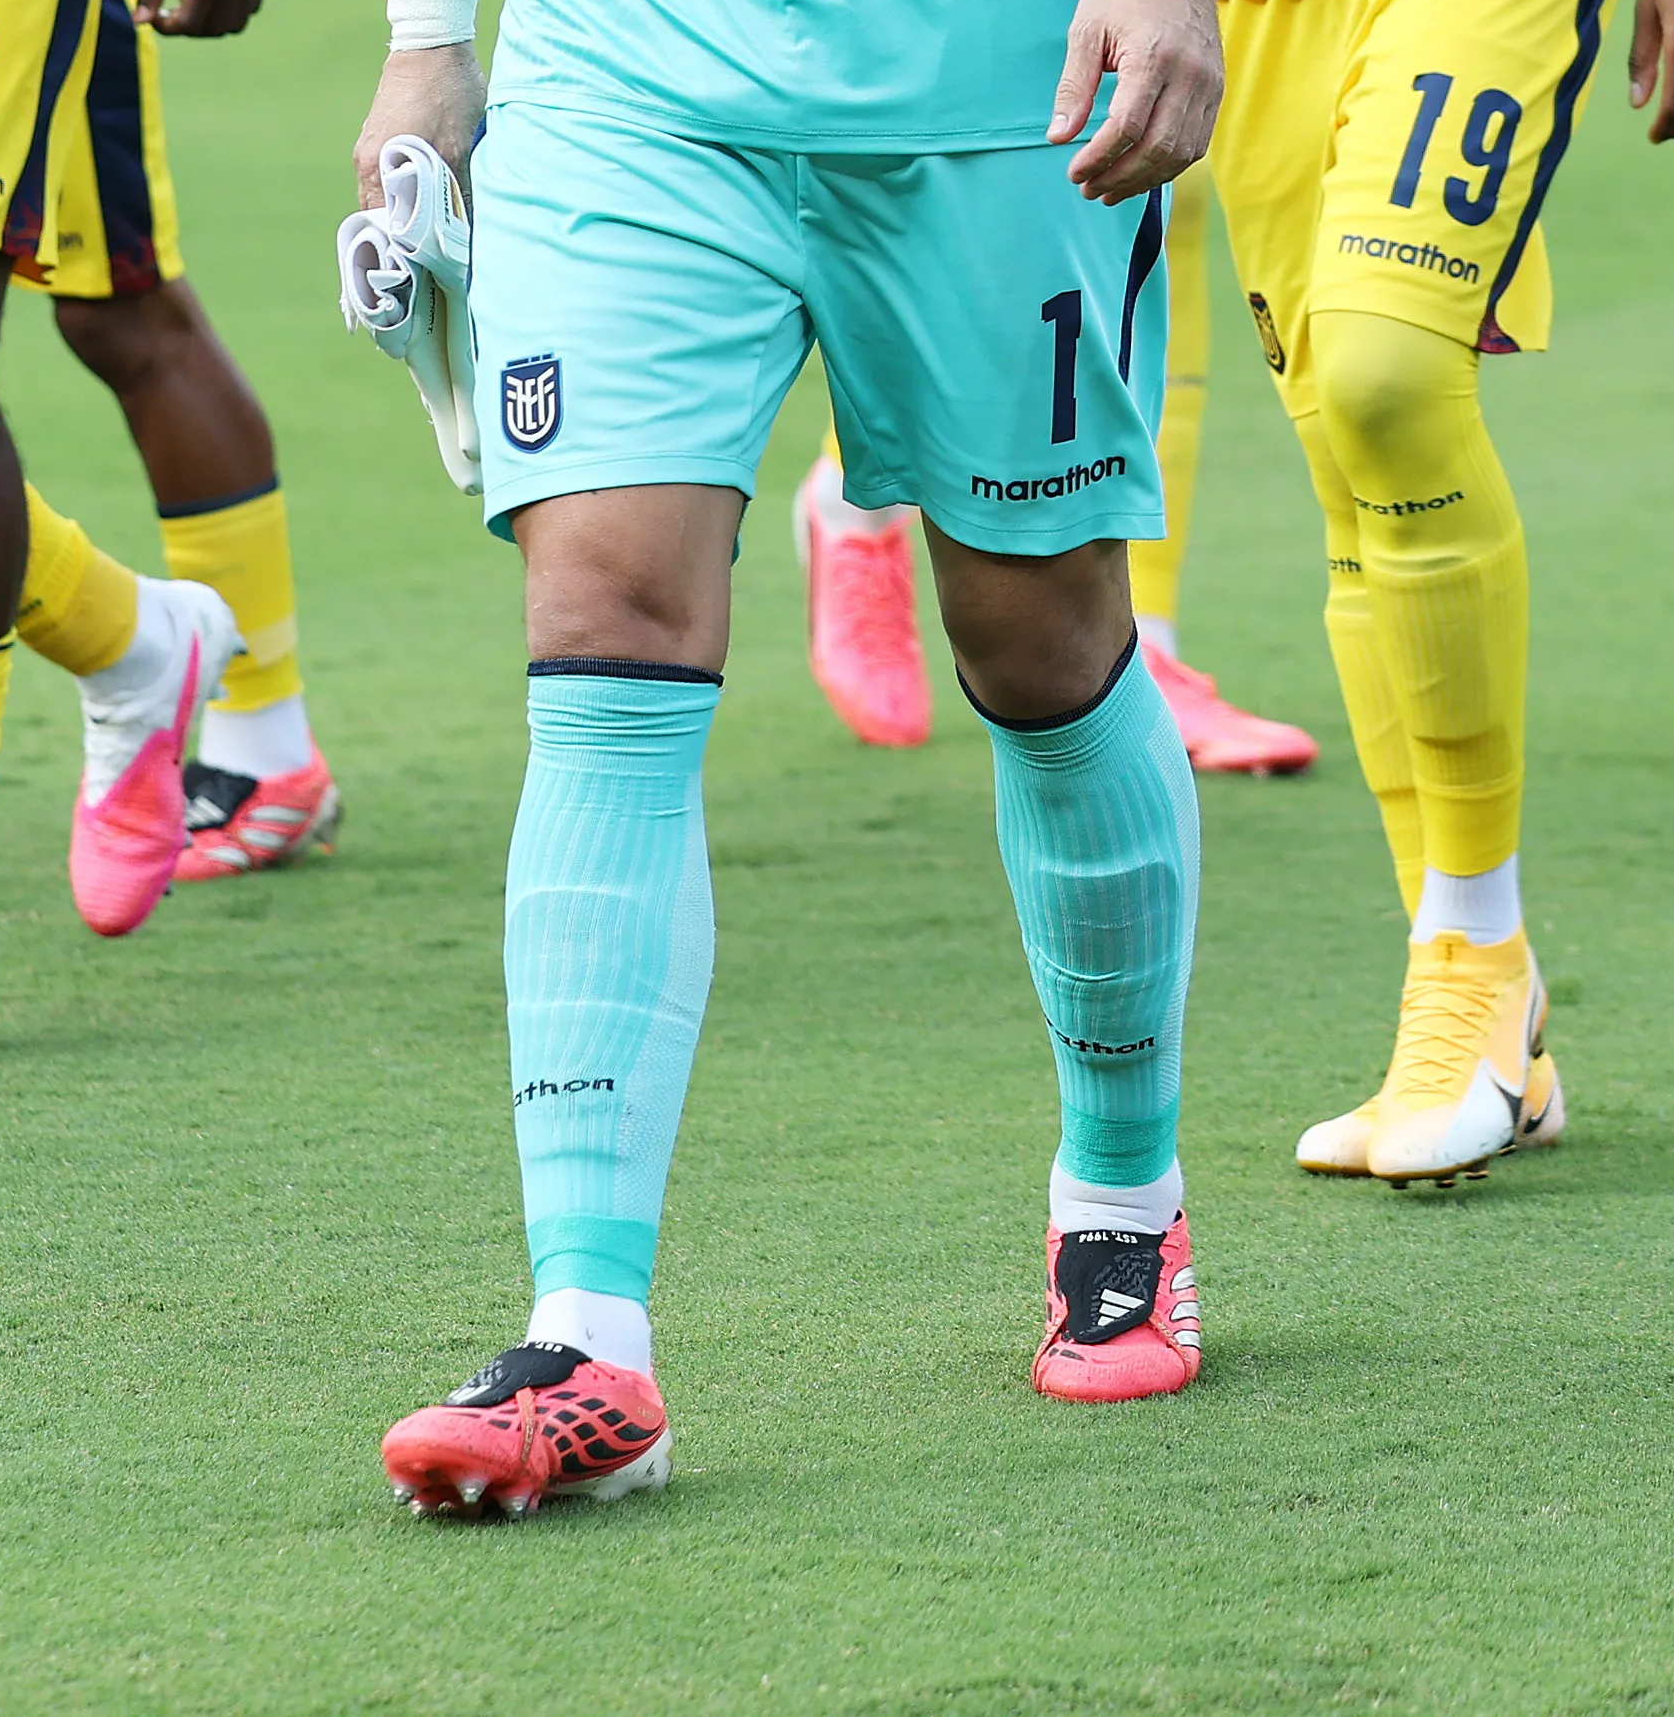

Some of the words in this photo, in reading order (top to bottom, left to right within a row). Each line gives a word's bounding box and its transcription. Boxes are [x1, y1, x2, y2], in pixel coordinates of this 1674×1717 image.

[1389, 71, 1524, 227] 19
[1338, 231, 1481, 284] marathon
[1040, 288, 1084, 445] 1
[971, 451, 1126, 502] marathon
